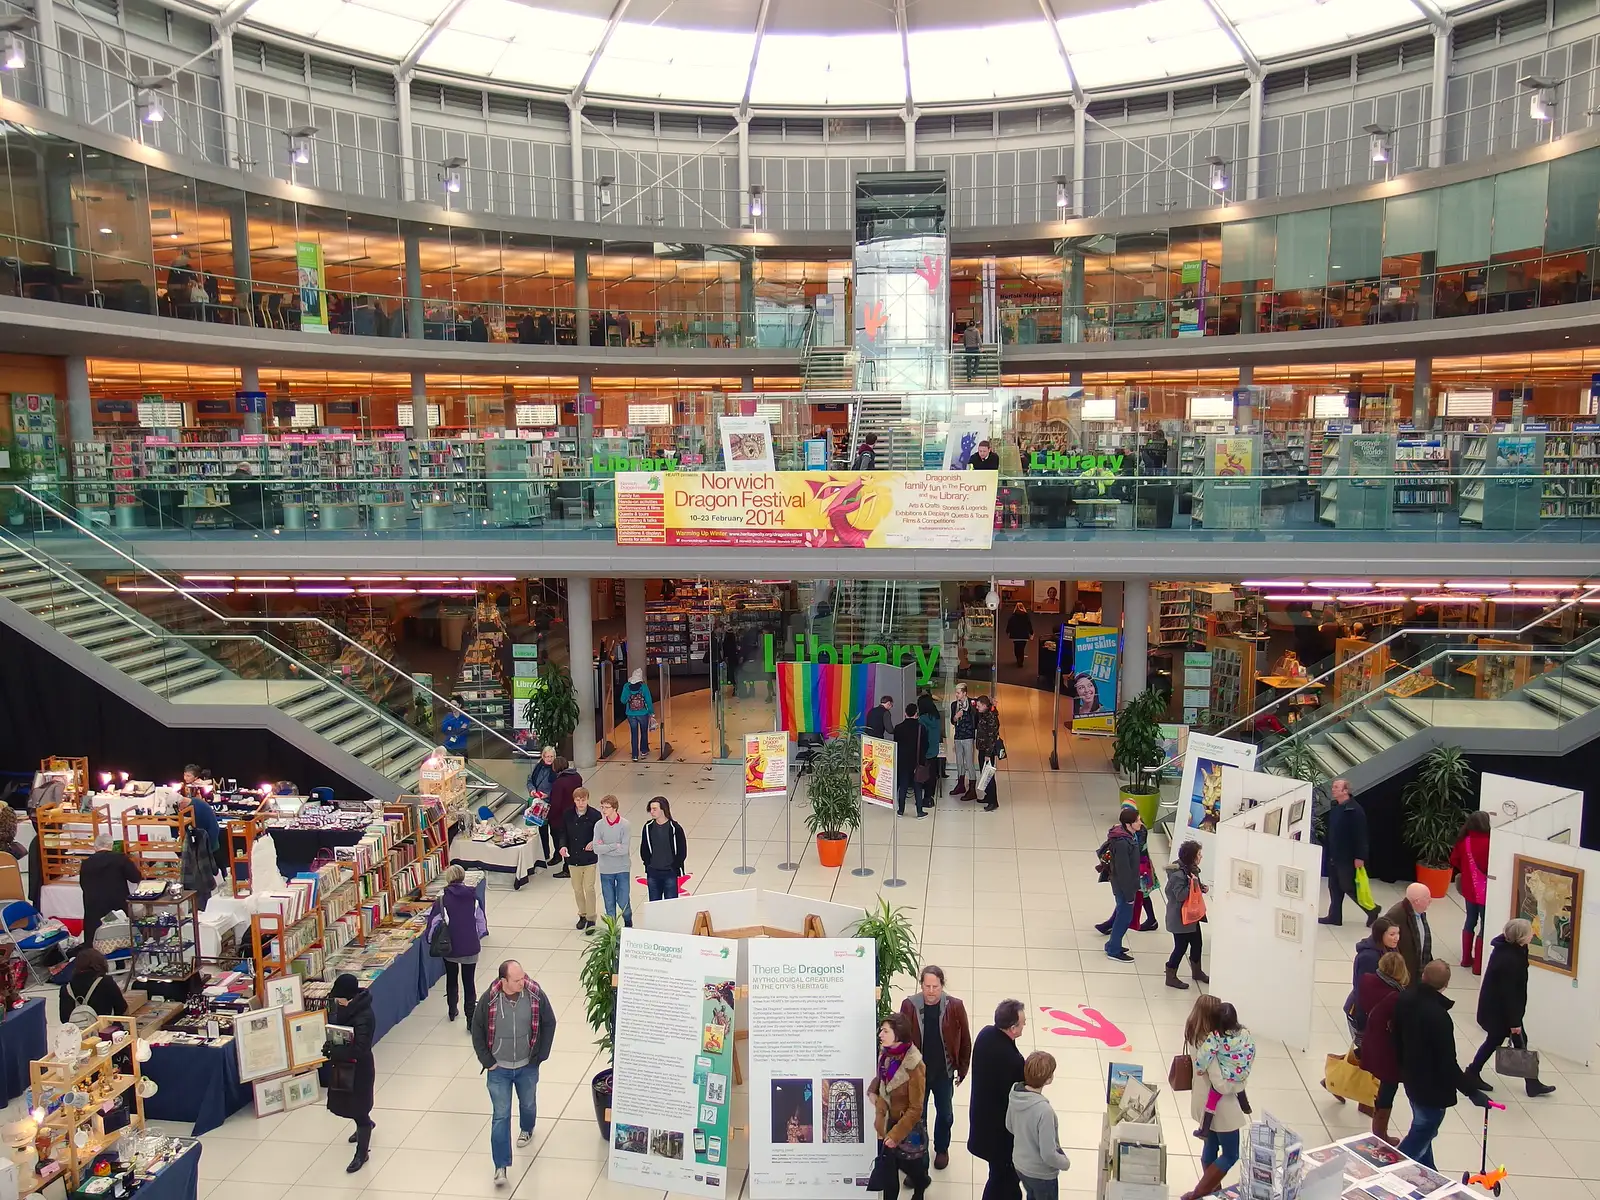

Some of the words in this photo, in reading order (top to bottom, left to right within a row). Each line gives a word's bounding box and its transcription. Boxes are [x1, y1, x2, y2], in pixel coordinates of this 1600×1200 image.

[593, 455, 678, 472] Library
[1030, 450, 1124, 472] Library
[702, 473, 774, 490] Norwich
[926, 474, 961, 482] Dragonish
[904, 482, 928, 491] family
[959, 483, 987, 491] Forum
[675, 490, 737, 511] Dragon
[742, 491, 806, 508] Festival
[940, 492, 969, 501] Library:
[712, 515, 743, 523] February
[745, 509, 785, 525] 2014
[1077, 643, 1093, 651] new
[1095, 640, 1116, 649] skills
[764, 634, 940, 686] Library
[1095, 654, 1114, 666] GET
[626, 940, 642, 949] There
[653, 944, 683, 953] Dragons!
[625, 949, 657, 957] MYTHOLOGICAL
[752, 965, 780, 974] There
[782, 964, 796, 974] Be
[798, 964, 845, 975] Dragons!
[703, 1108, 714, 1122] 12
